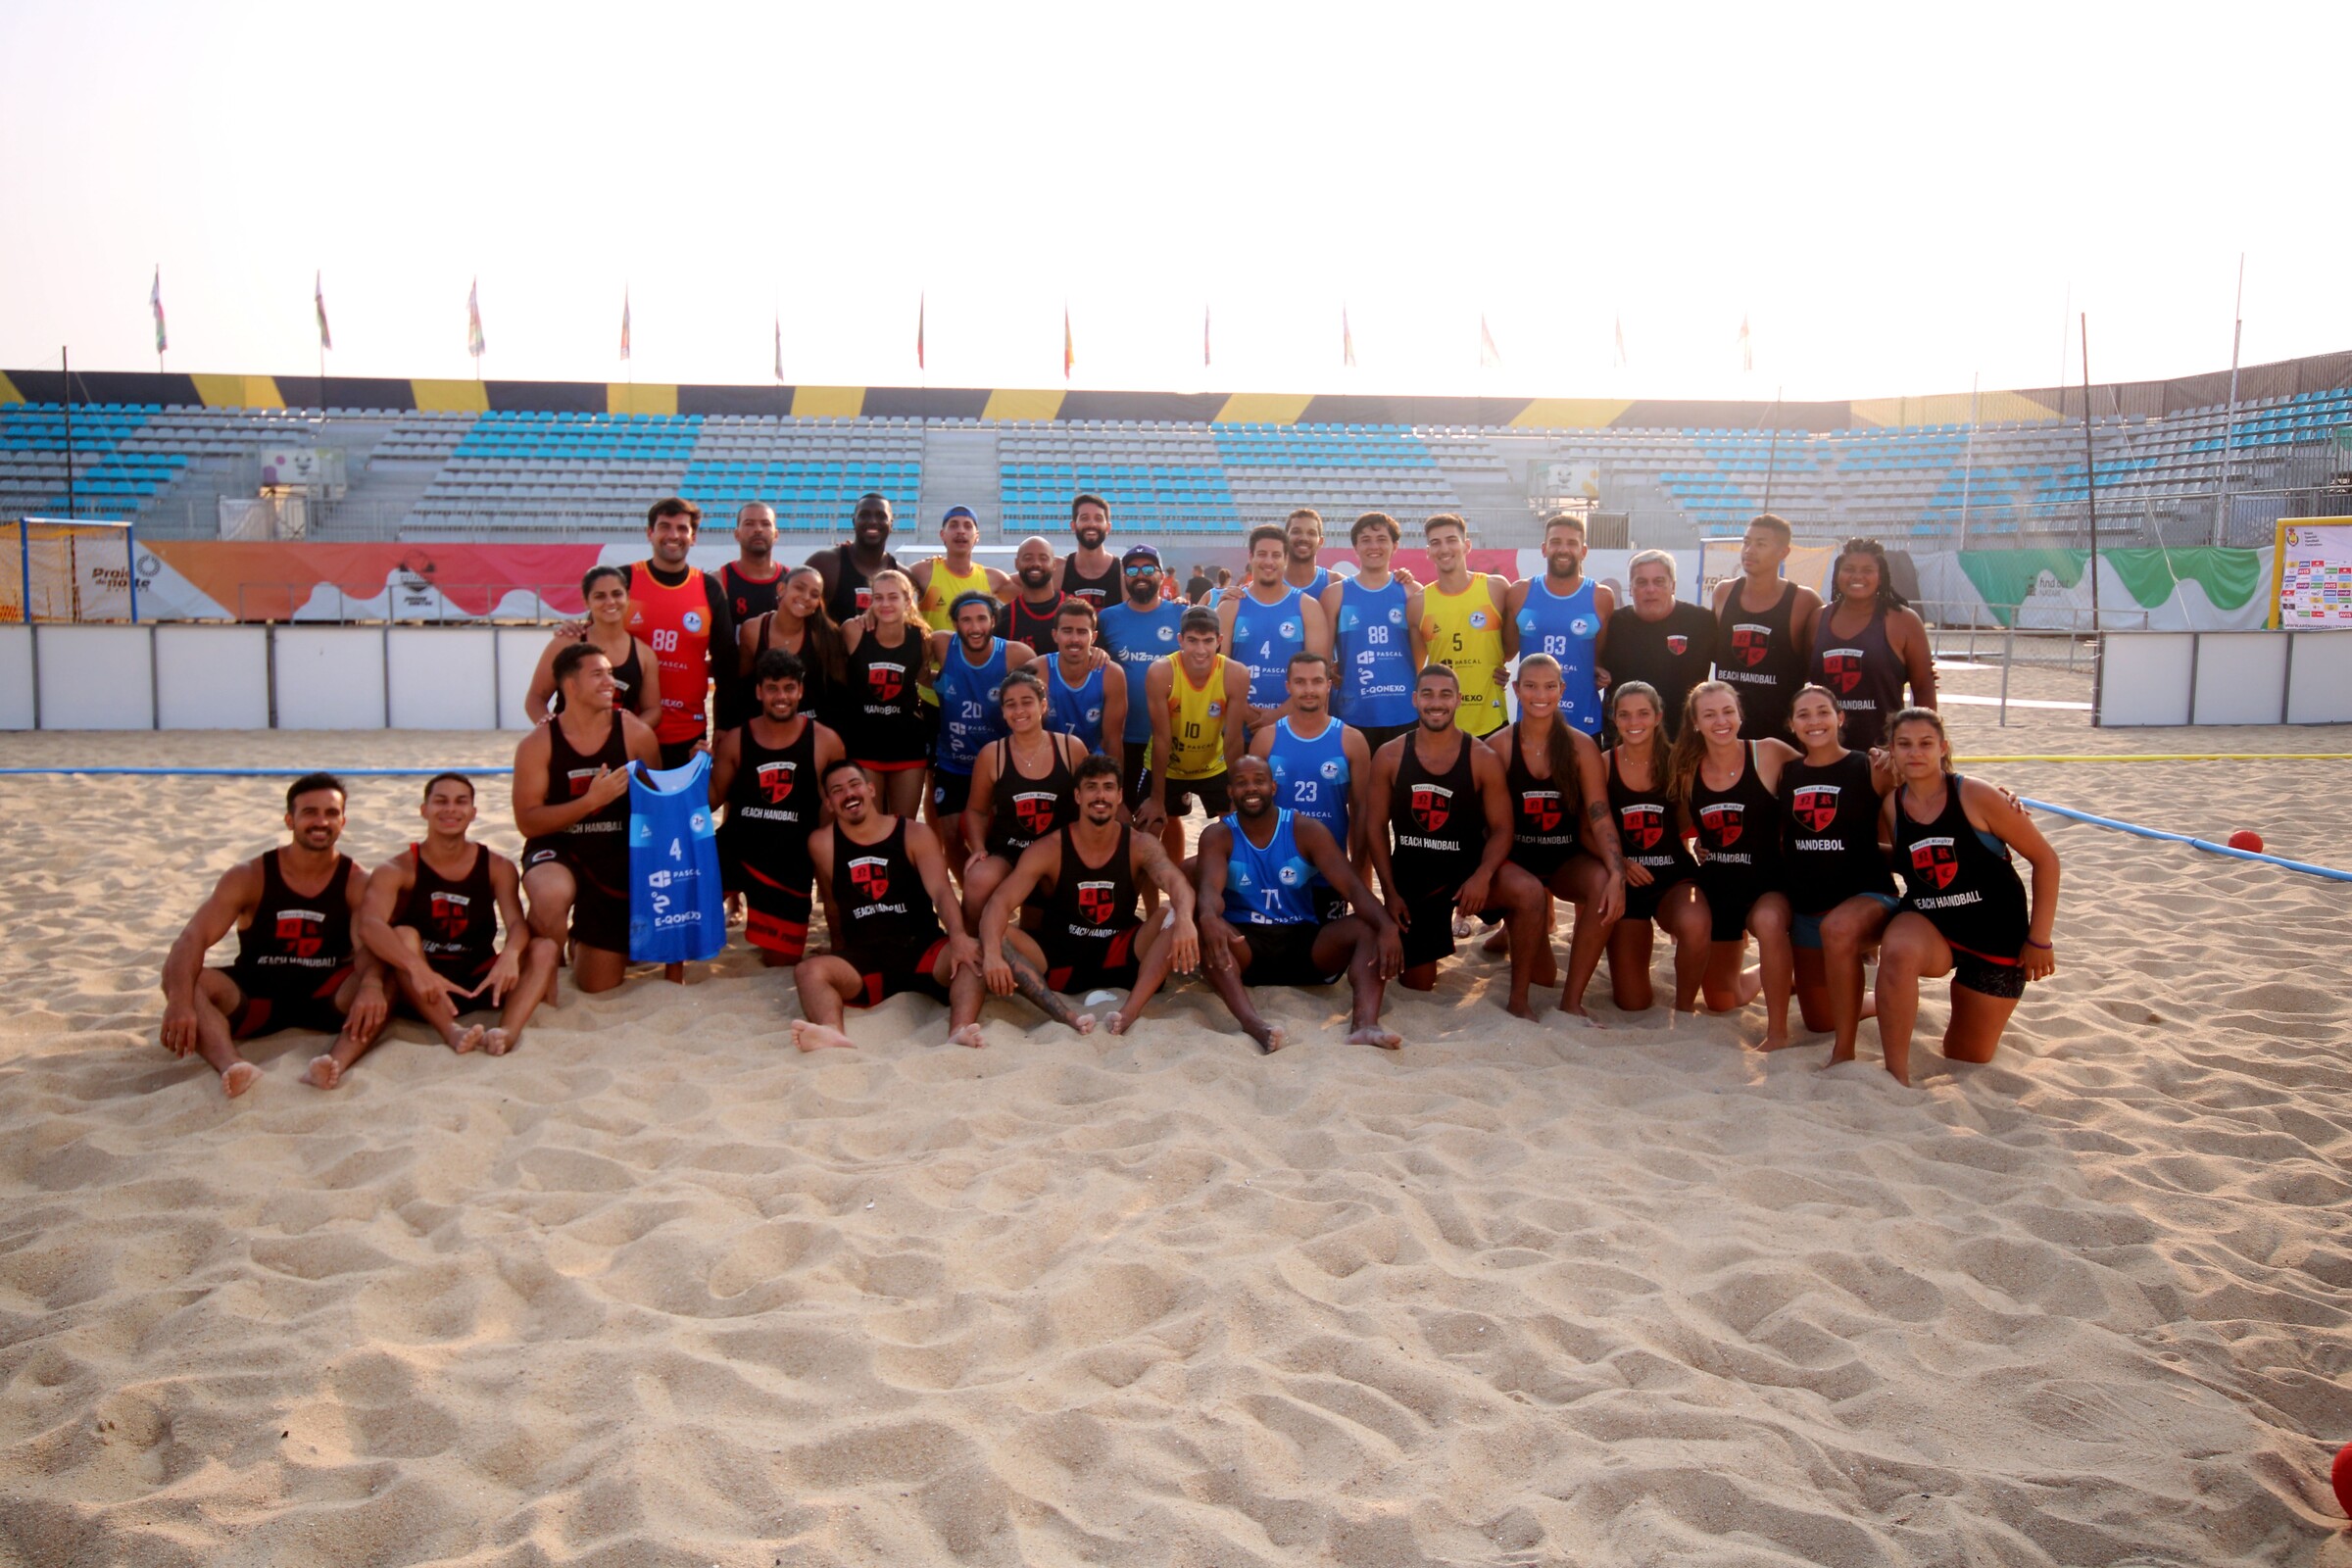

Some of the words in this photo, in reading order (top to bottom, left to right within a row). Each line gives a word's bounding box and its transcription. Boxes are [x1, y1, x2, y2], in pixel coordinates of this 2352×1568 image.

[106, 578, 151, 588] note
[737, 597, 748, 614] 8
[652, 629, 678, 652] 88
[1368, 625, 1389, 644] 88
[1452, 633, 1462, 652] 5
[1260, 640, 1271, 660] 4
[1544, 635, 1566, 655] 83
[1718, 669, 1740, 680] BEACH
[1740, 672, 1777, 685] HANDBALL
[1360, 685, 1406, 696] E-QONEXO
[961, 701, 982, 718] 20
[1185, 721, 1200, 739] 10
[1295, 781, 1317, 802] 23
[741, 807, 763, 818] BEACH
[763, 808, 799, 822] HANDBALL
[1301, 810, 1332, 823] PASCAL
[1399, 835, 1422, 848] BEACH
[1423, 838, 1460, 852] HANDBALL
[1537, 834, 1572, 845] HANDBALL
[1795, 839, 1844, 851] HANDEBOL
[669, 838, 682, 861] 4
[1717, 852, 1751, 864] HANDBALL
[1936, 890, 1983, 908] HANDBALL
